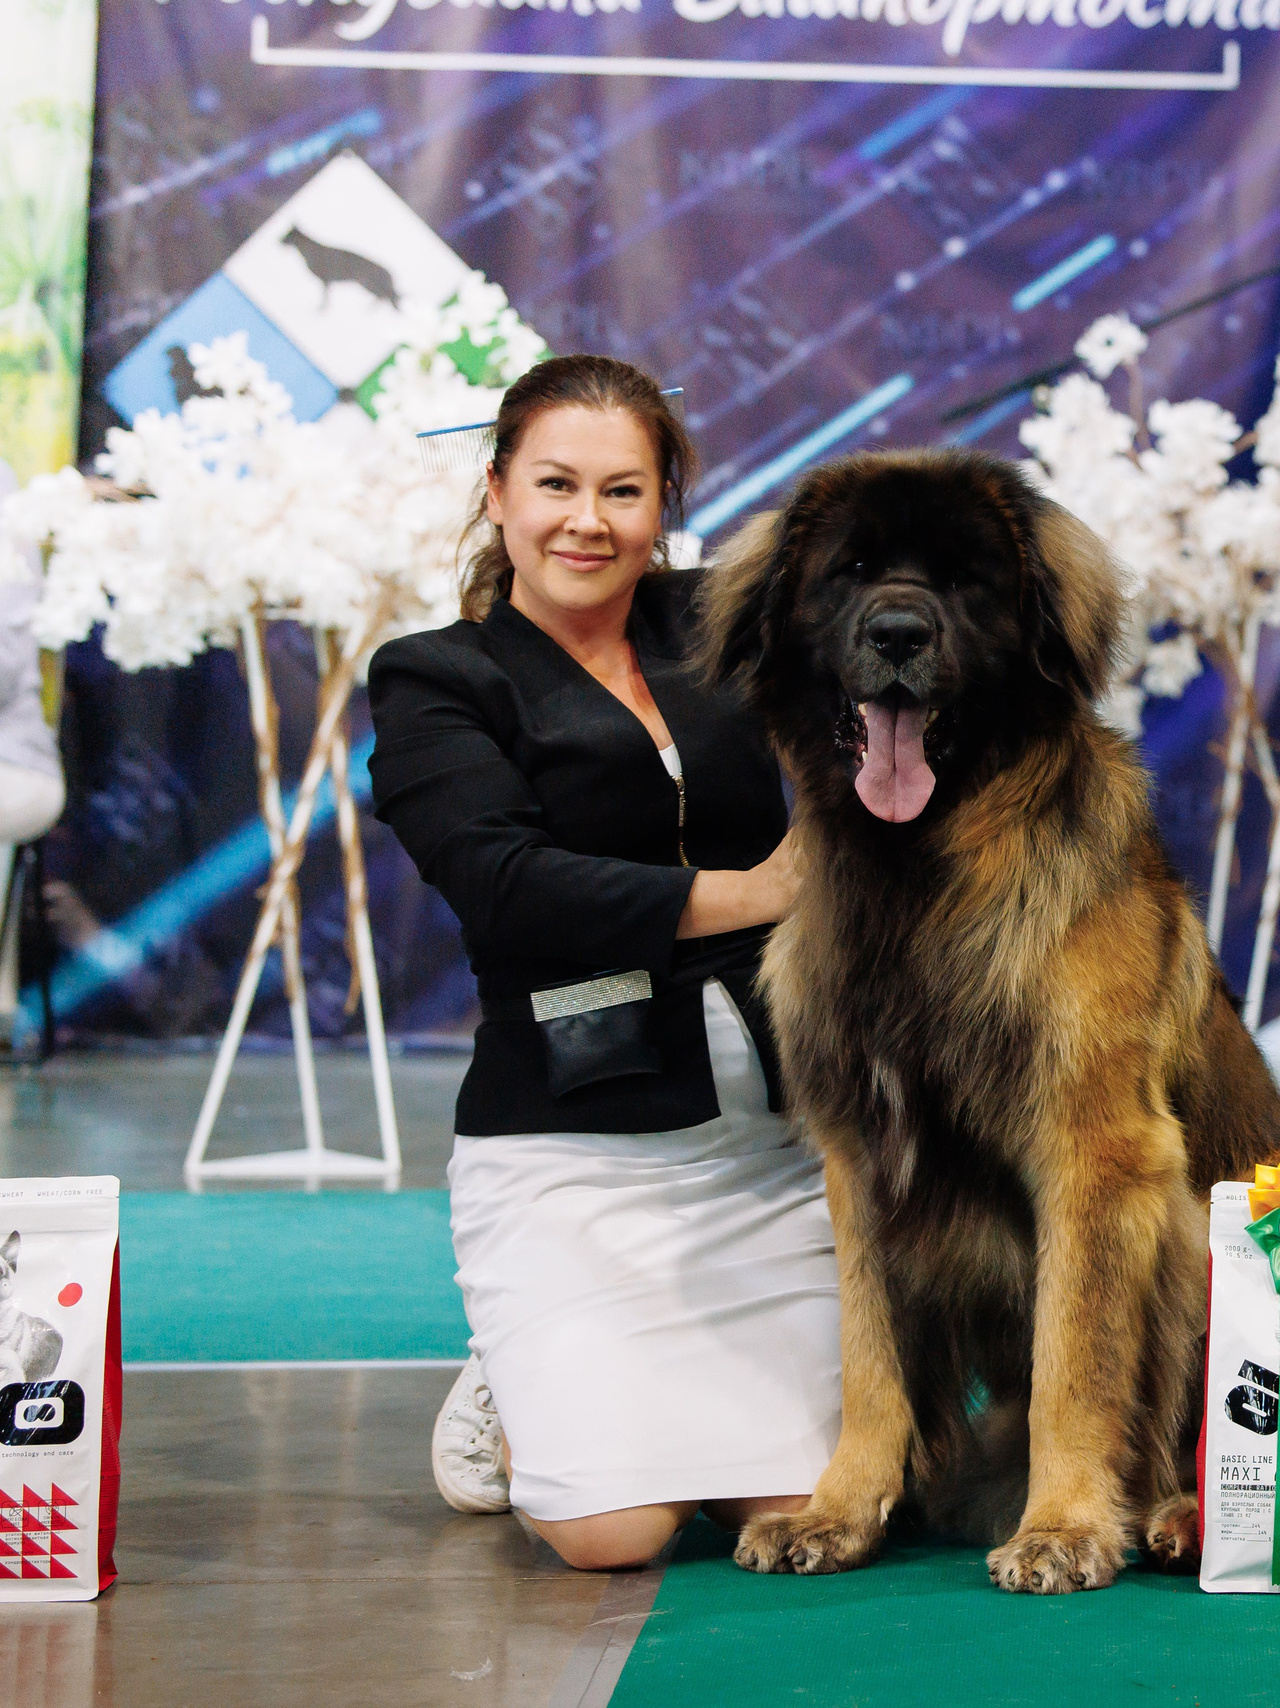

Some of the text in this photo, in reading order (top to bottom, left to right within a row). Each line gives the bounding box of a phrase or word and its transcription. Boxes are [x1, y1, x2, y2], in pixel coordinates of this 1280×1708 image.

[1221, 1455, 1273, 1464] BASIC LINE
[1220, 1466, 1261, 1481] MAXI
